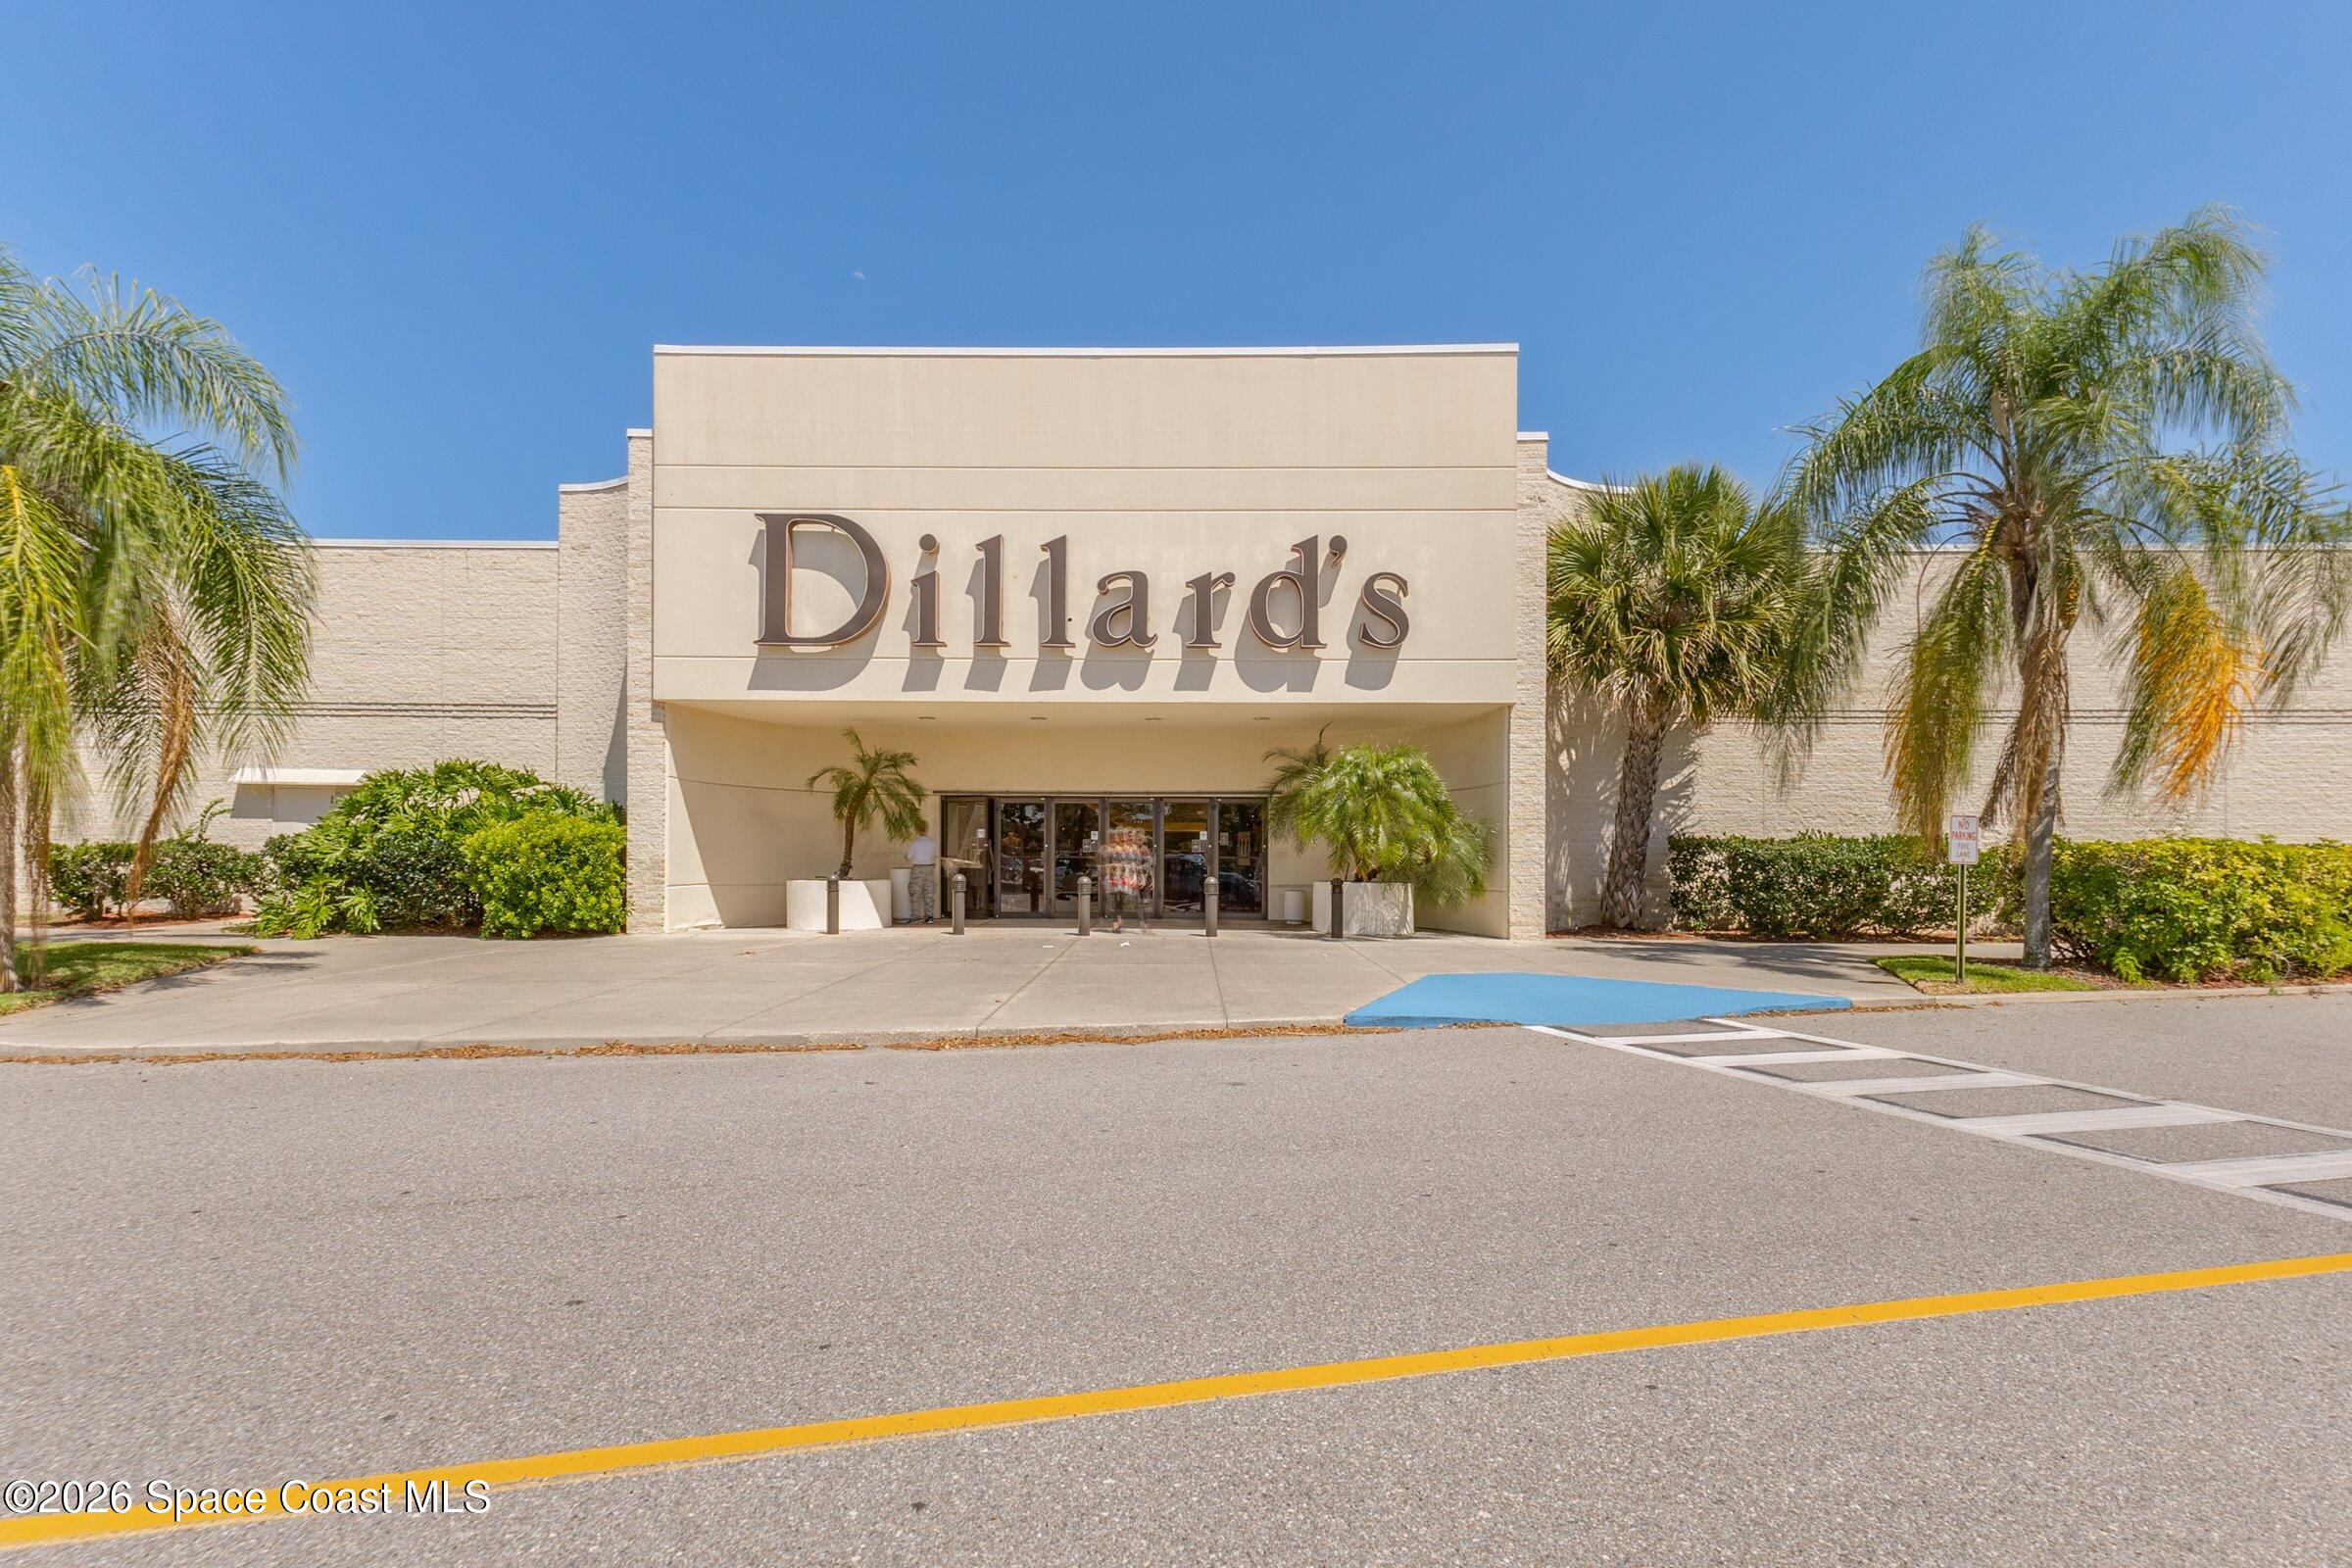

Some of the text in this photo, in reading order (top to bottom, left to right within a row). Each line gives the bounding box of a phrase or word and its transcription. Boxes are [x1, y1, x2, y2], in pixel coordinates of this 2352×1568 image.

[753, 513, 1410, 650] Dillard's
[1958, 820, 1970, 830] NO
[1952, 831, 1976, 840] PARKING
